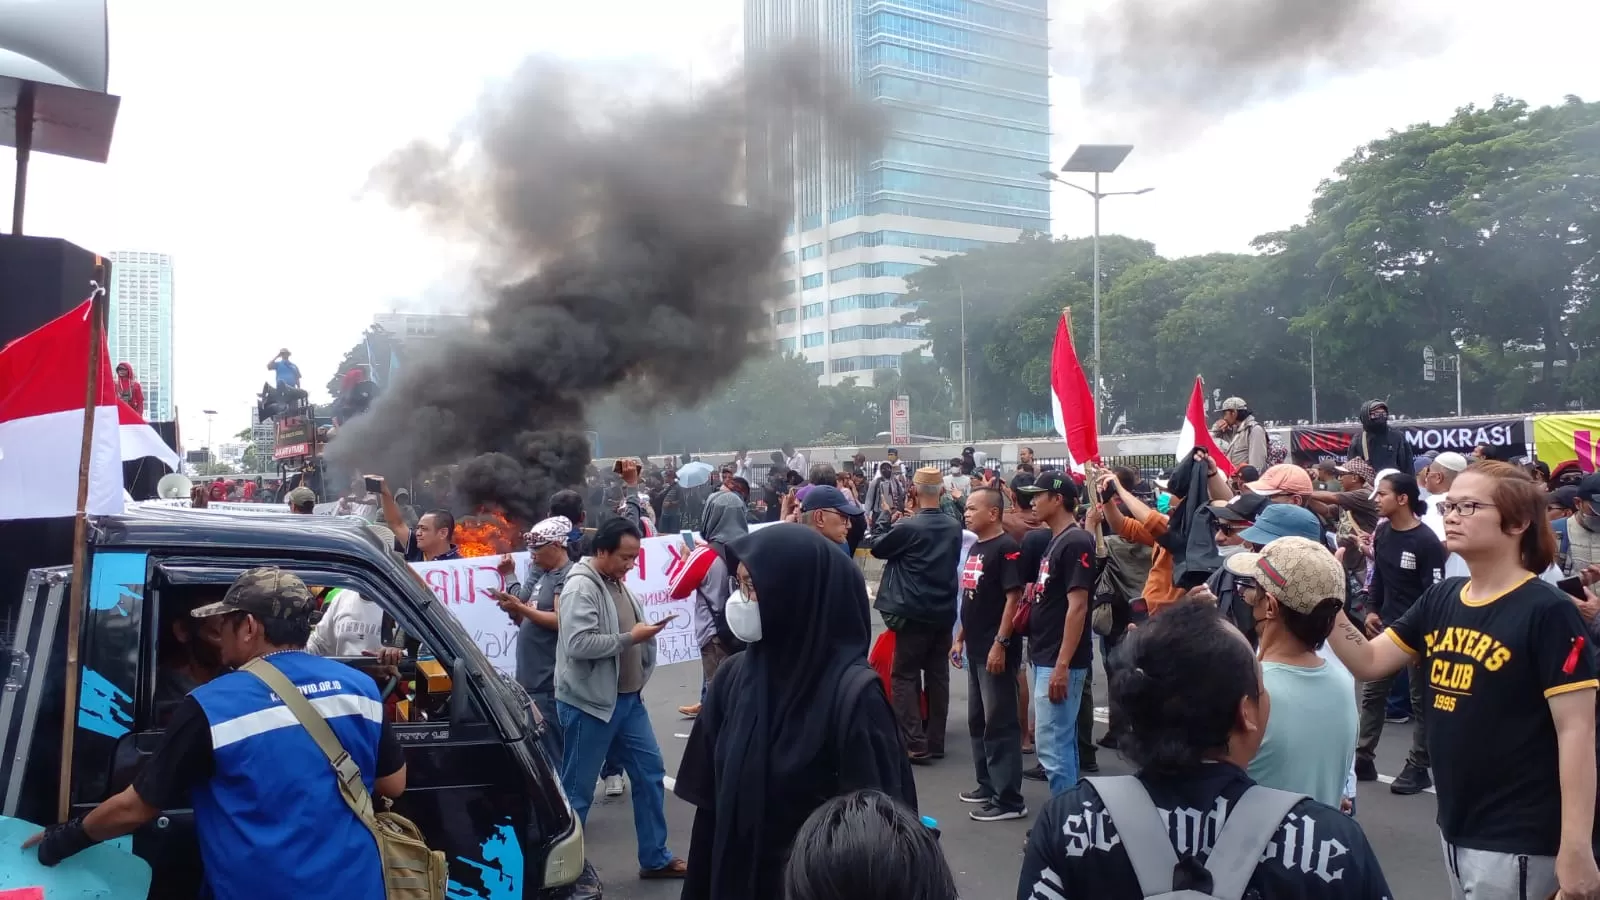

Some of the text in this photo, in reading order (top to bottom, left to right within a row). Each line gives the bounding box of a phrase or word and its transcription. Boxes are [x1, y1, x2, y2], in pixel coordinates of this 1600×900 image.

[1405, 426, 1512, 449] MOKRASI
[1424, 627, 1511, 671] PLAYER'S
[1430, 659, 1474, 690] CLUB
[1433, 694, 1457, 712] 1995
